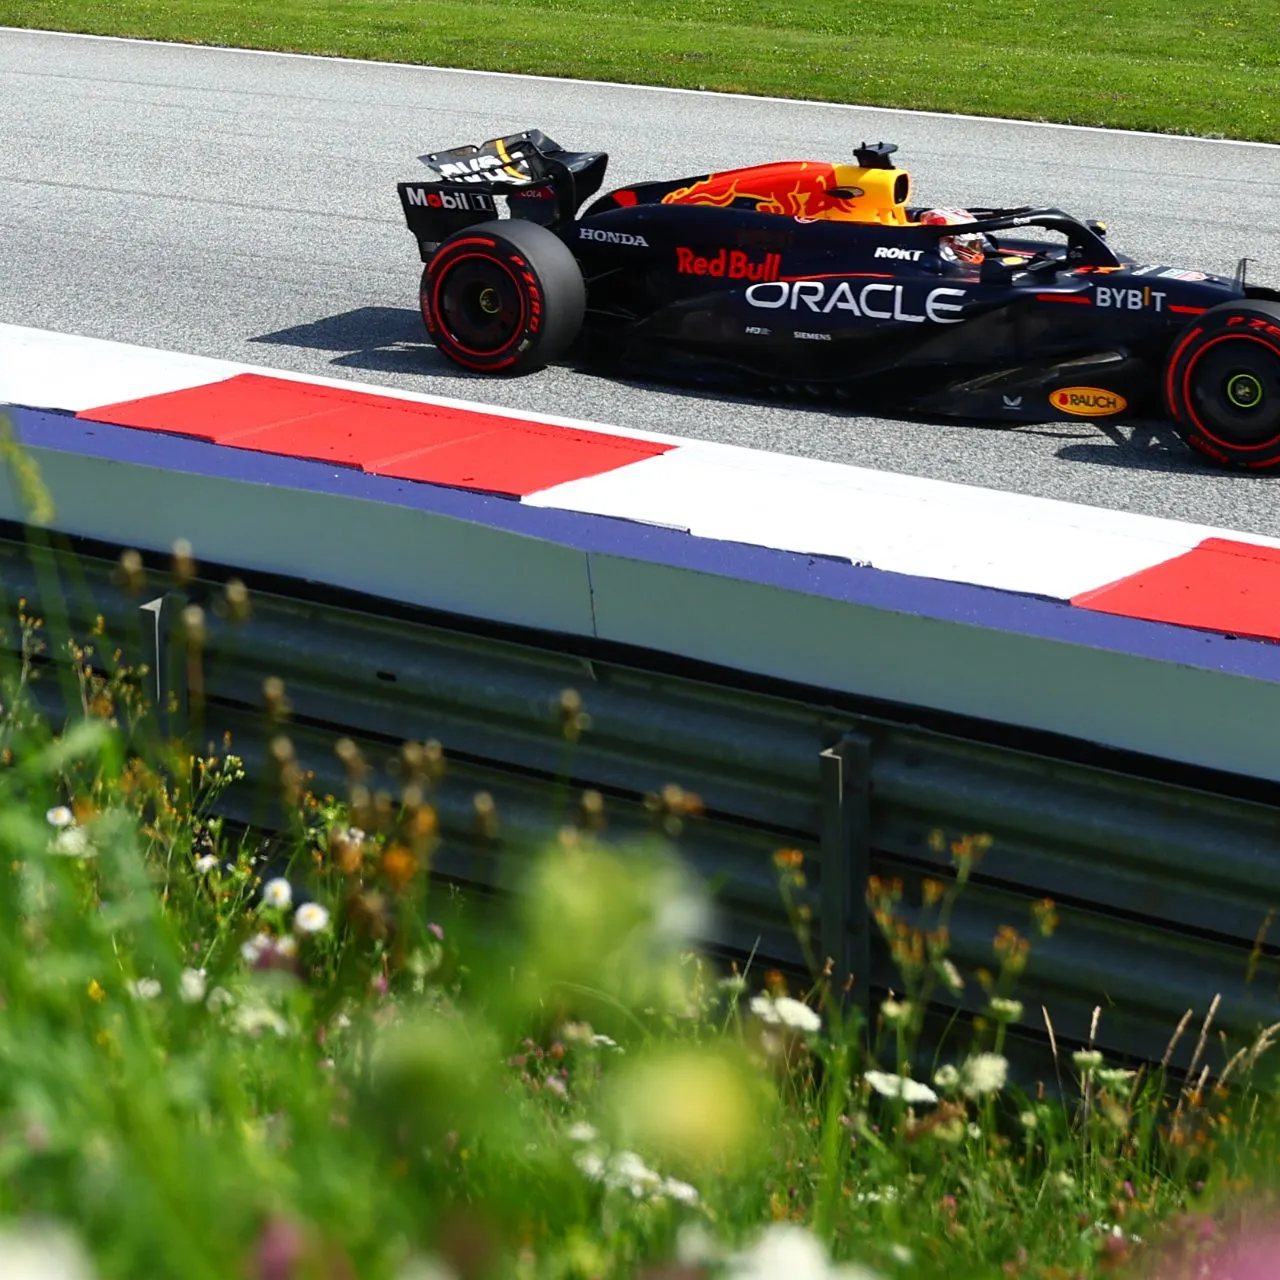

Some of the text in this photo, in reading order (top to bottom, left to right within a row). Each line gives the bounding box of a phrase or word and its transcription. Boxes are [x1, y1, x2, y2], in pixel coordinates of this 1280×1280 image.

[406, 187, 470, 210] Mobil
[579, 227, 650, 248] HONDA
[676, 247, 782, 281] Red Bull
[873, 247, 925, 263] ROKT
[744, 281, 967, 324] ORACLE
[1095, 286, 1167, 312] BYBIT
[793, 330, 832, 341] SIEMENS
[1070, 393, 1117, 408] RAUCH
